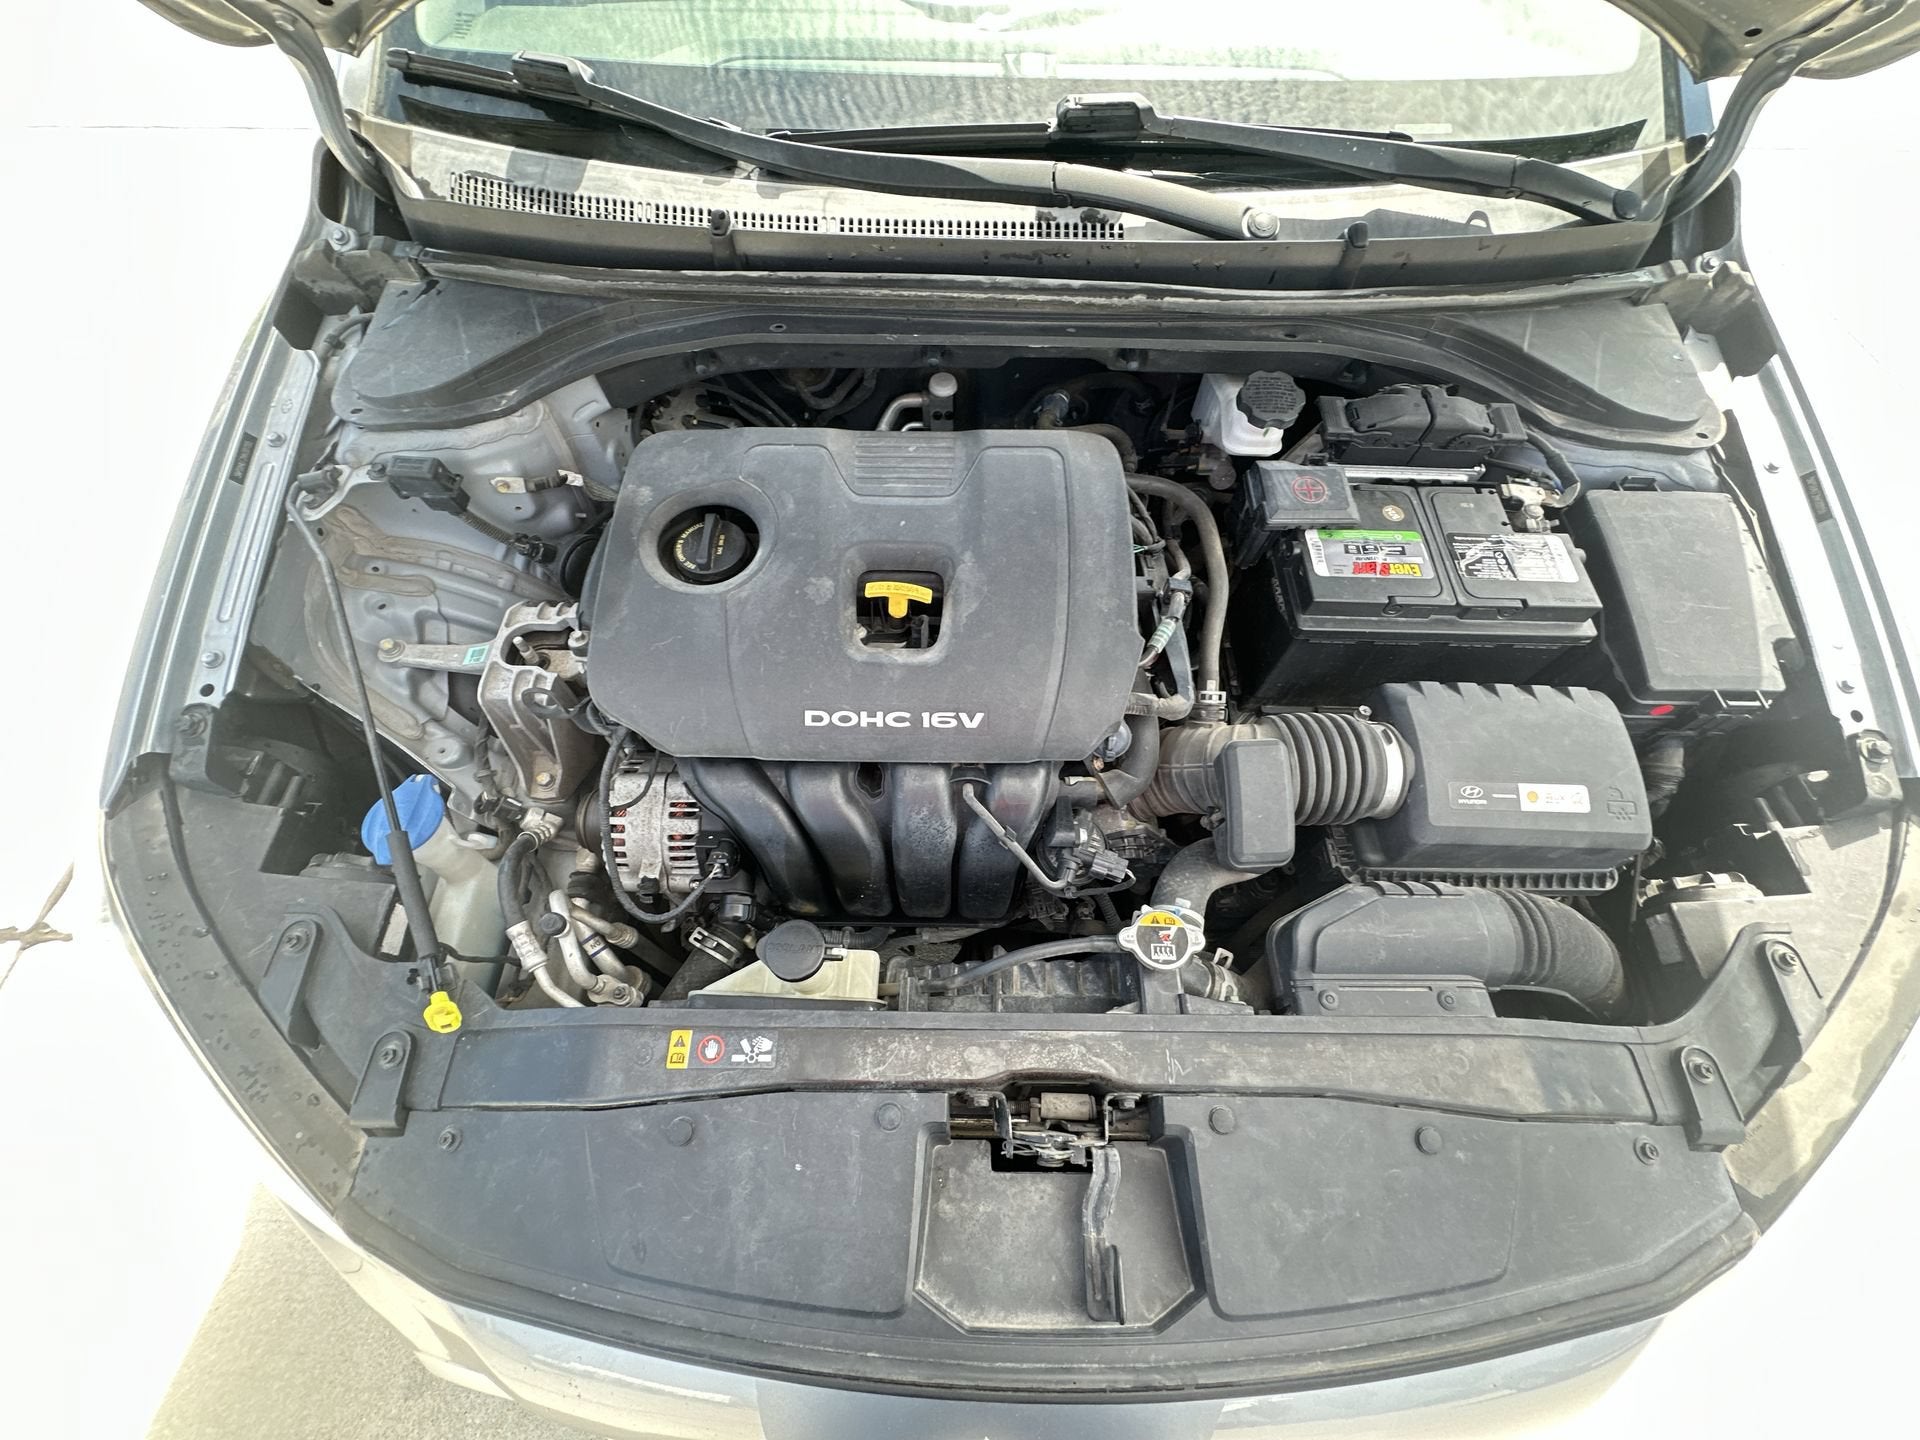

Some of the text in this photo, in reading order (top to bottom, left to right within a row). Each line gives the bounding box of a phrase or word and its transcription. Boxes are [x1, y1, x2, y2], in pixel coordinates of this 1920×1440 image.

[1352, 561, 1423, 576] EverSart
[804, 709, 985, 729] DOHC 16V
[1457, 798, 1488, 806] HYUNDAI
[767, 942, 823, 955] COOLANT
